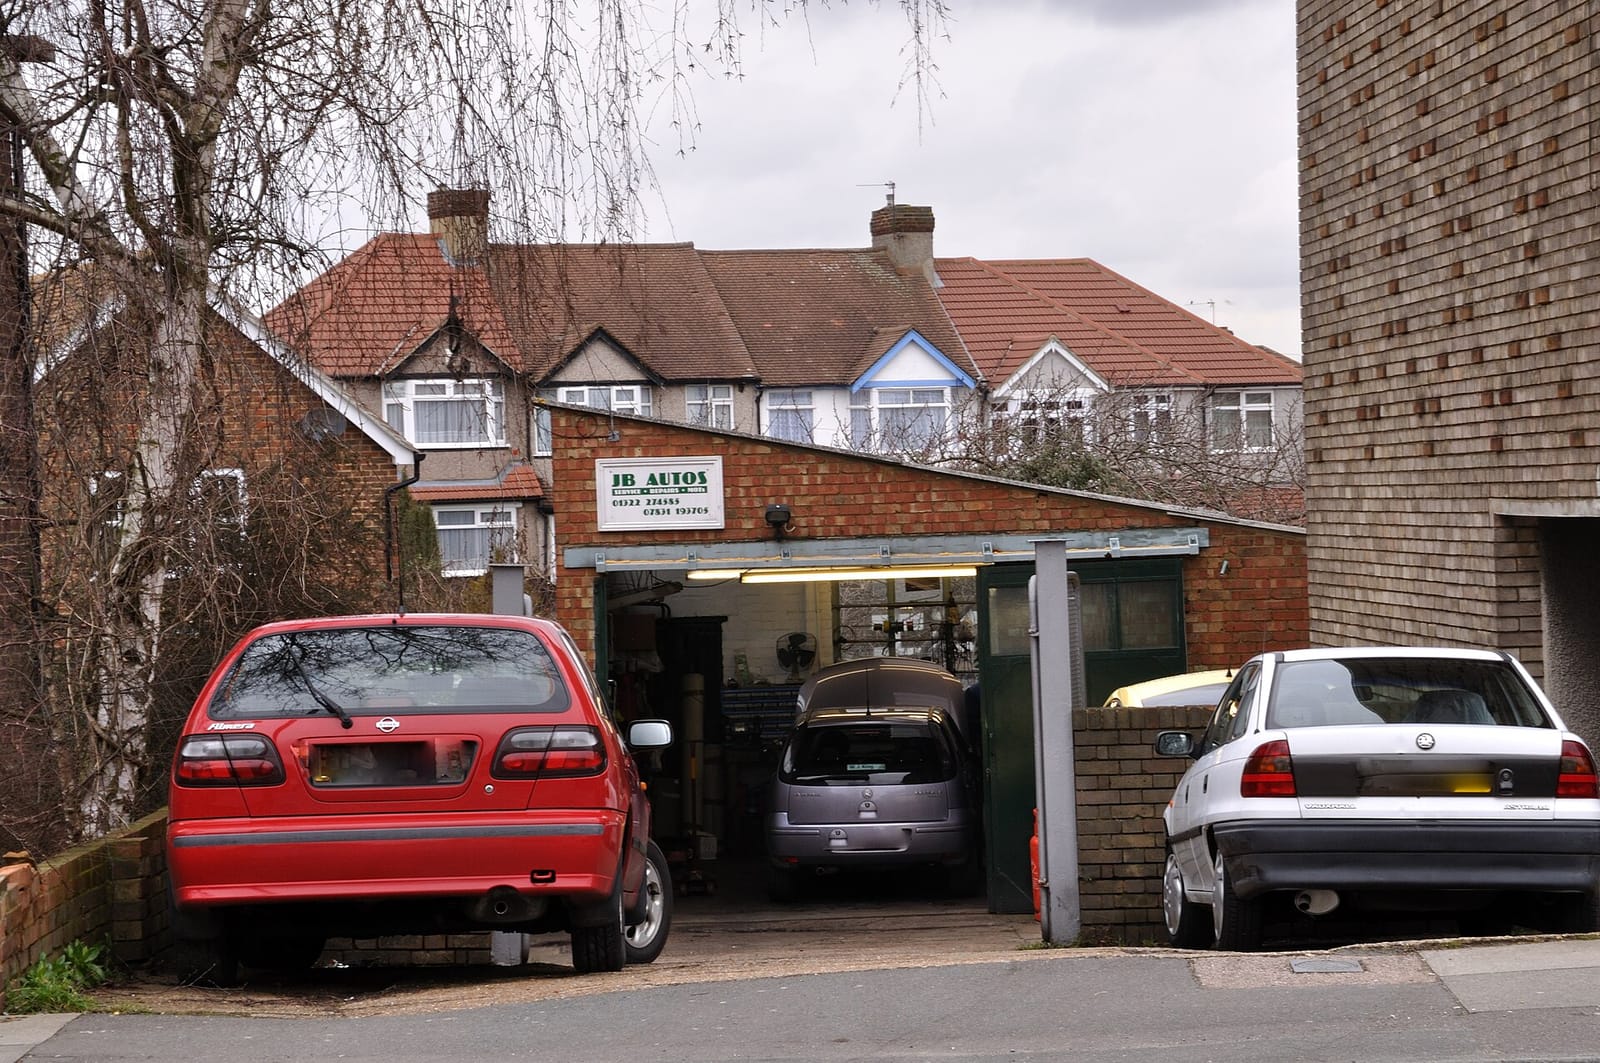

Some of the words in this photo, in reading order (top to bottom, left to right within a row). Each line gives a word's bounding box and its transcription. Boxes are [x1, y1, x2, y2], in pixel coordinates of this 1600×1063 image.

[612, 474, 636, 487] JB
[646, 471, 708, 486] AUTOS
[612, 499, 641, 507] 01322
[676, 507, 709, 515] 193705
